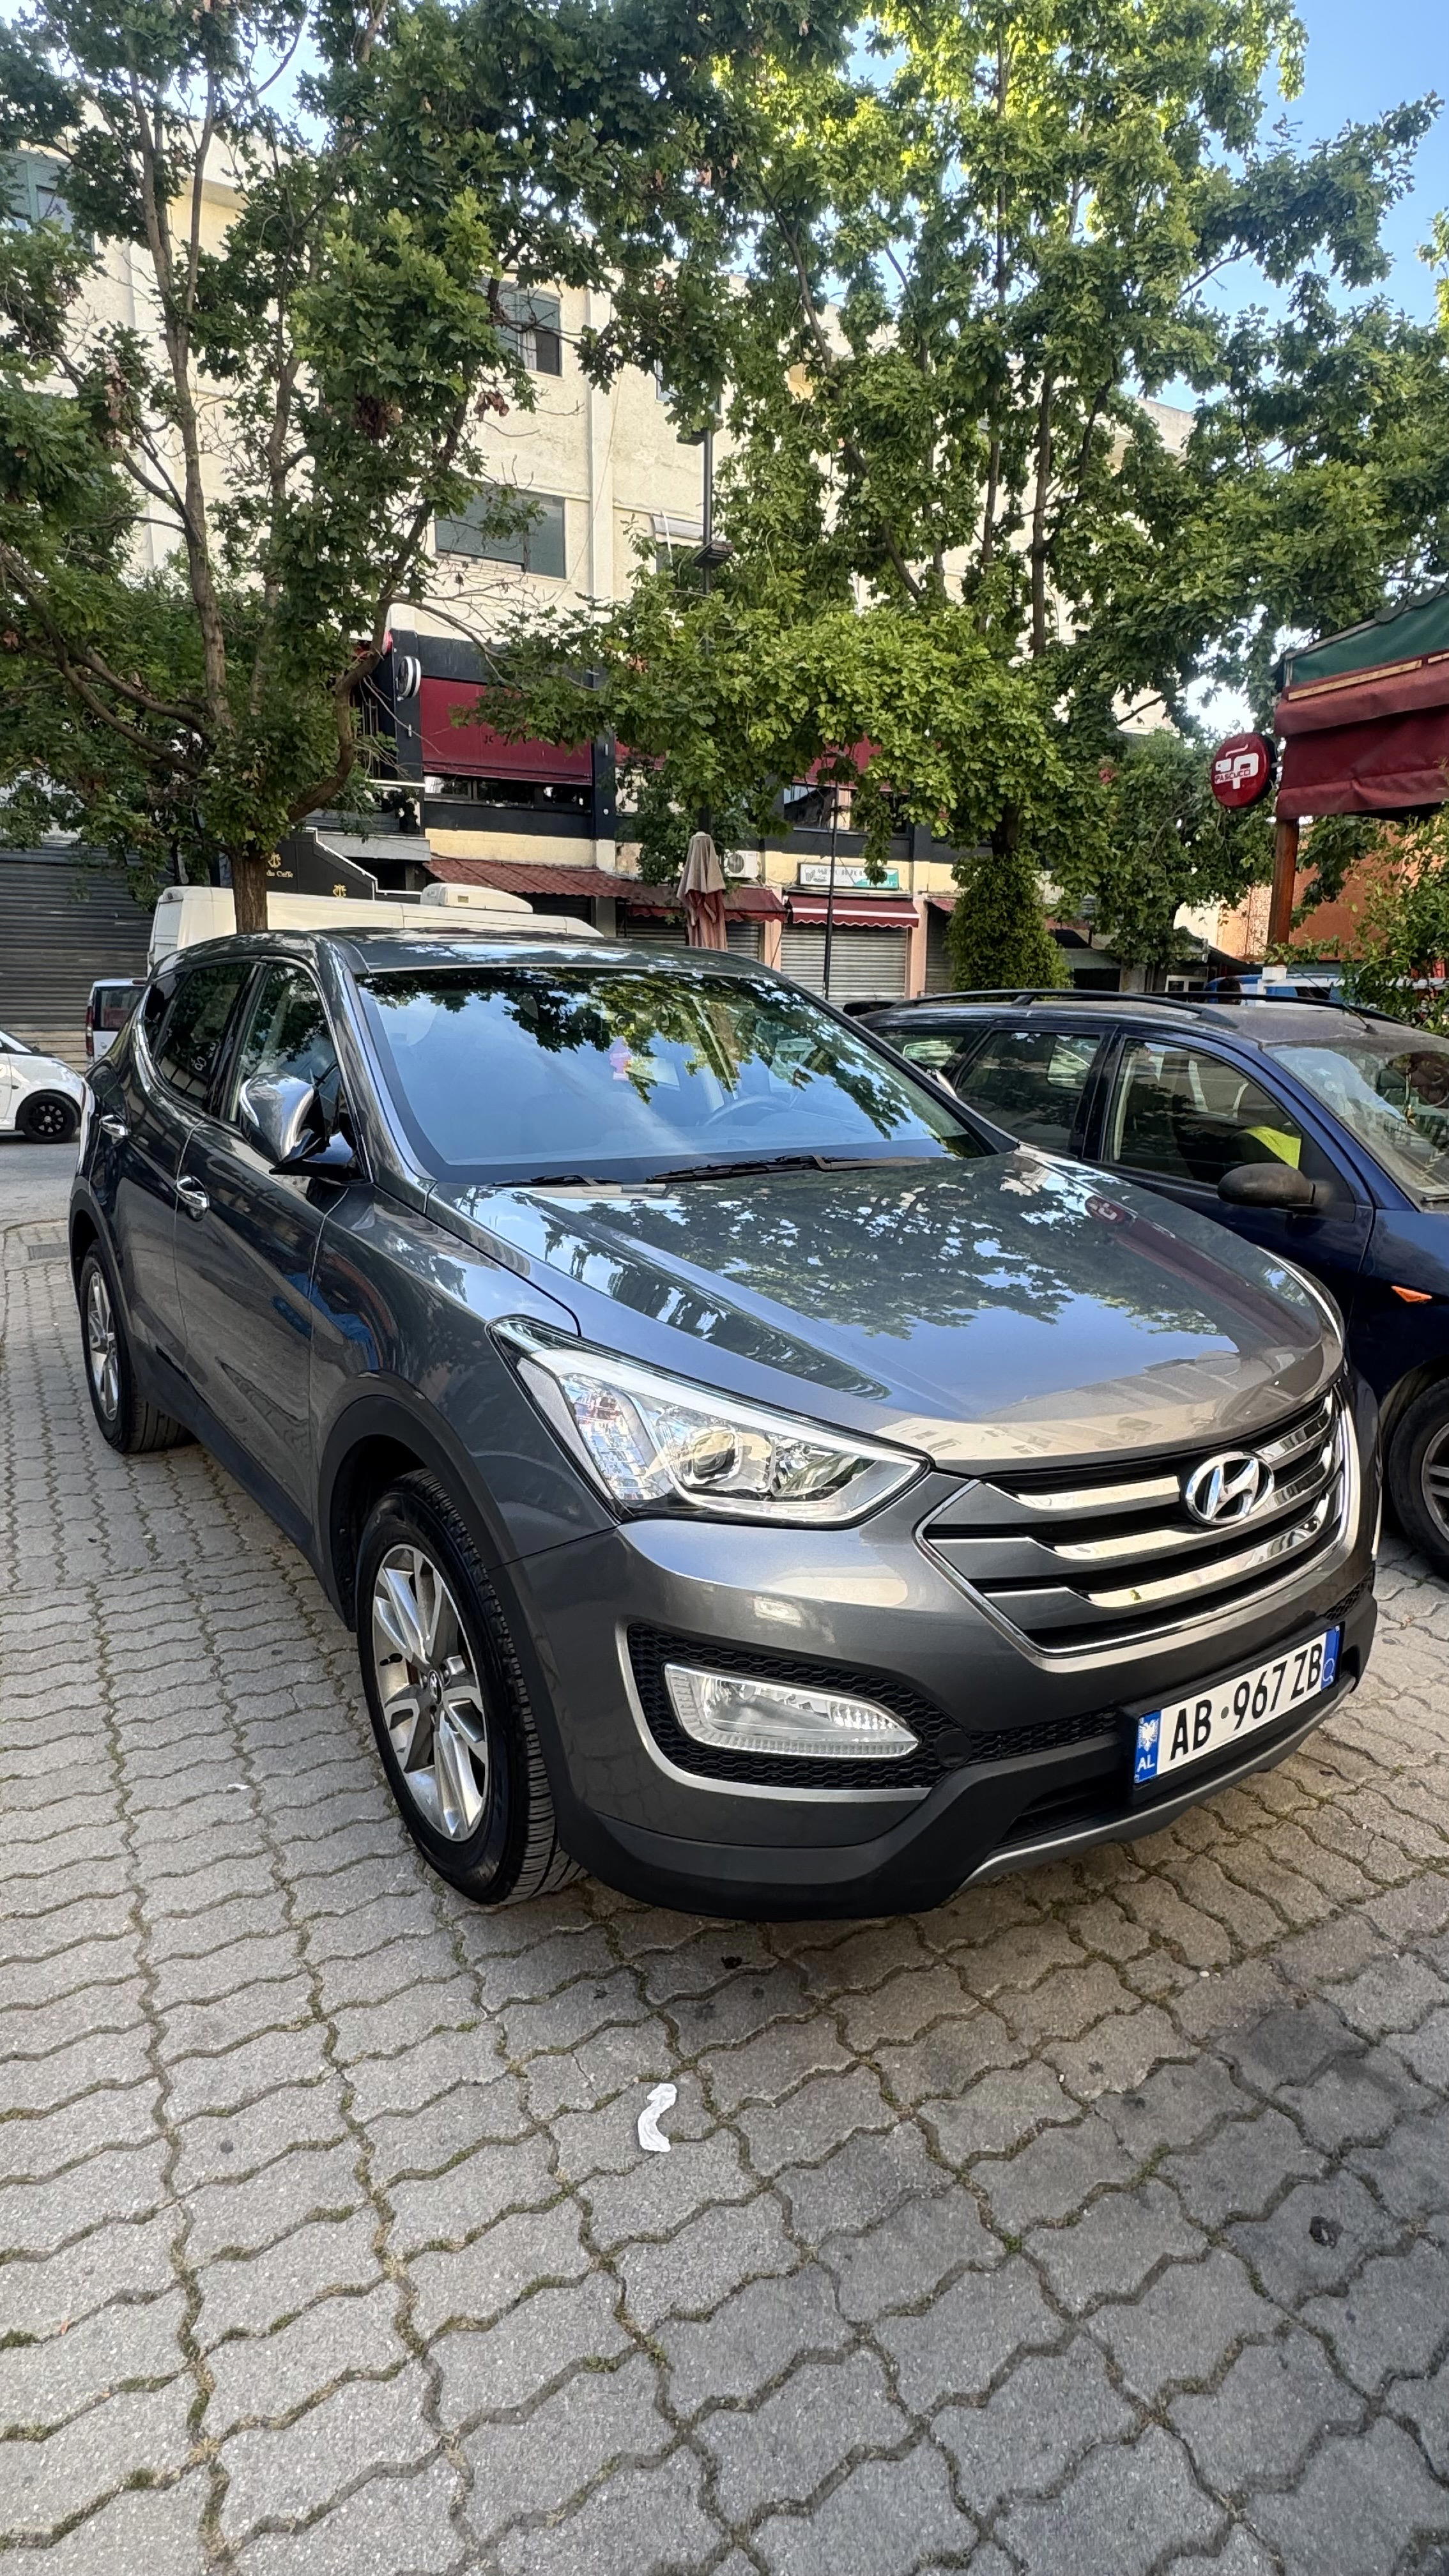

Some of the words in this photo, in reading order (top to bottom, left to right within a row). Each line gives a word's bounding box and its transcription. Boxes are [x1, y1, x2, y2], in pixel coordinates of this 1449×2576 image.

[1215, 769, 1251, 783] PASCUCCI
[1169, 1699, 1212, 1761] AB
[1233, 1660, 1288, 1731] 967
[1289, 1643, 1322, 1702] ZB
[1136, 1755, 1155, 1773] AL
